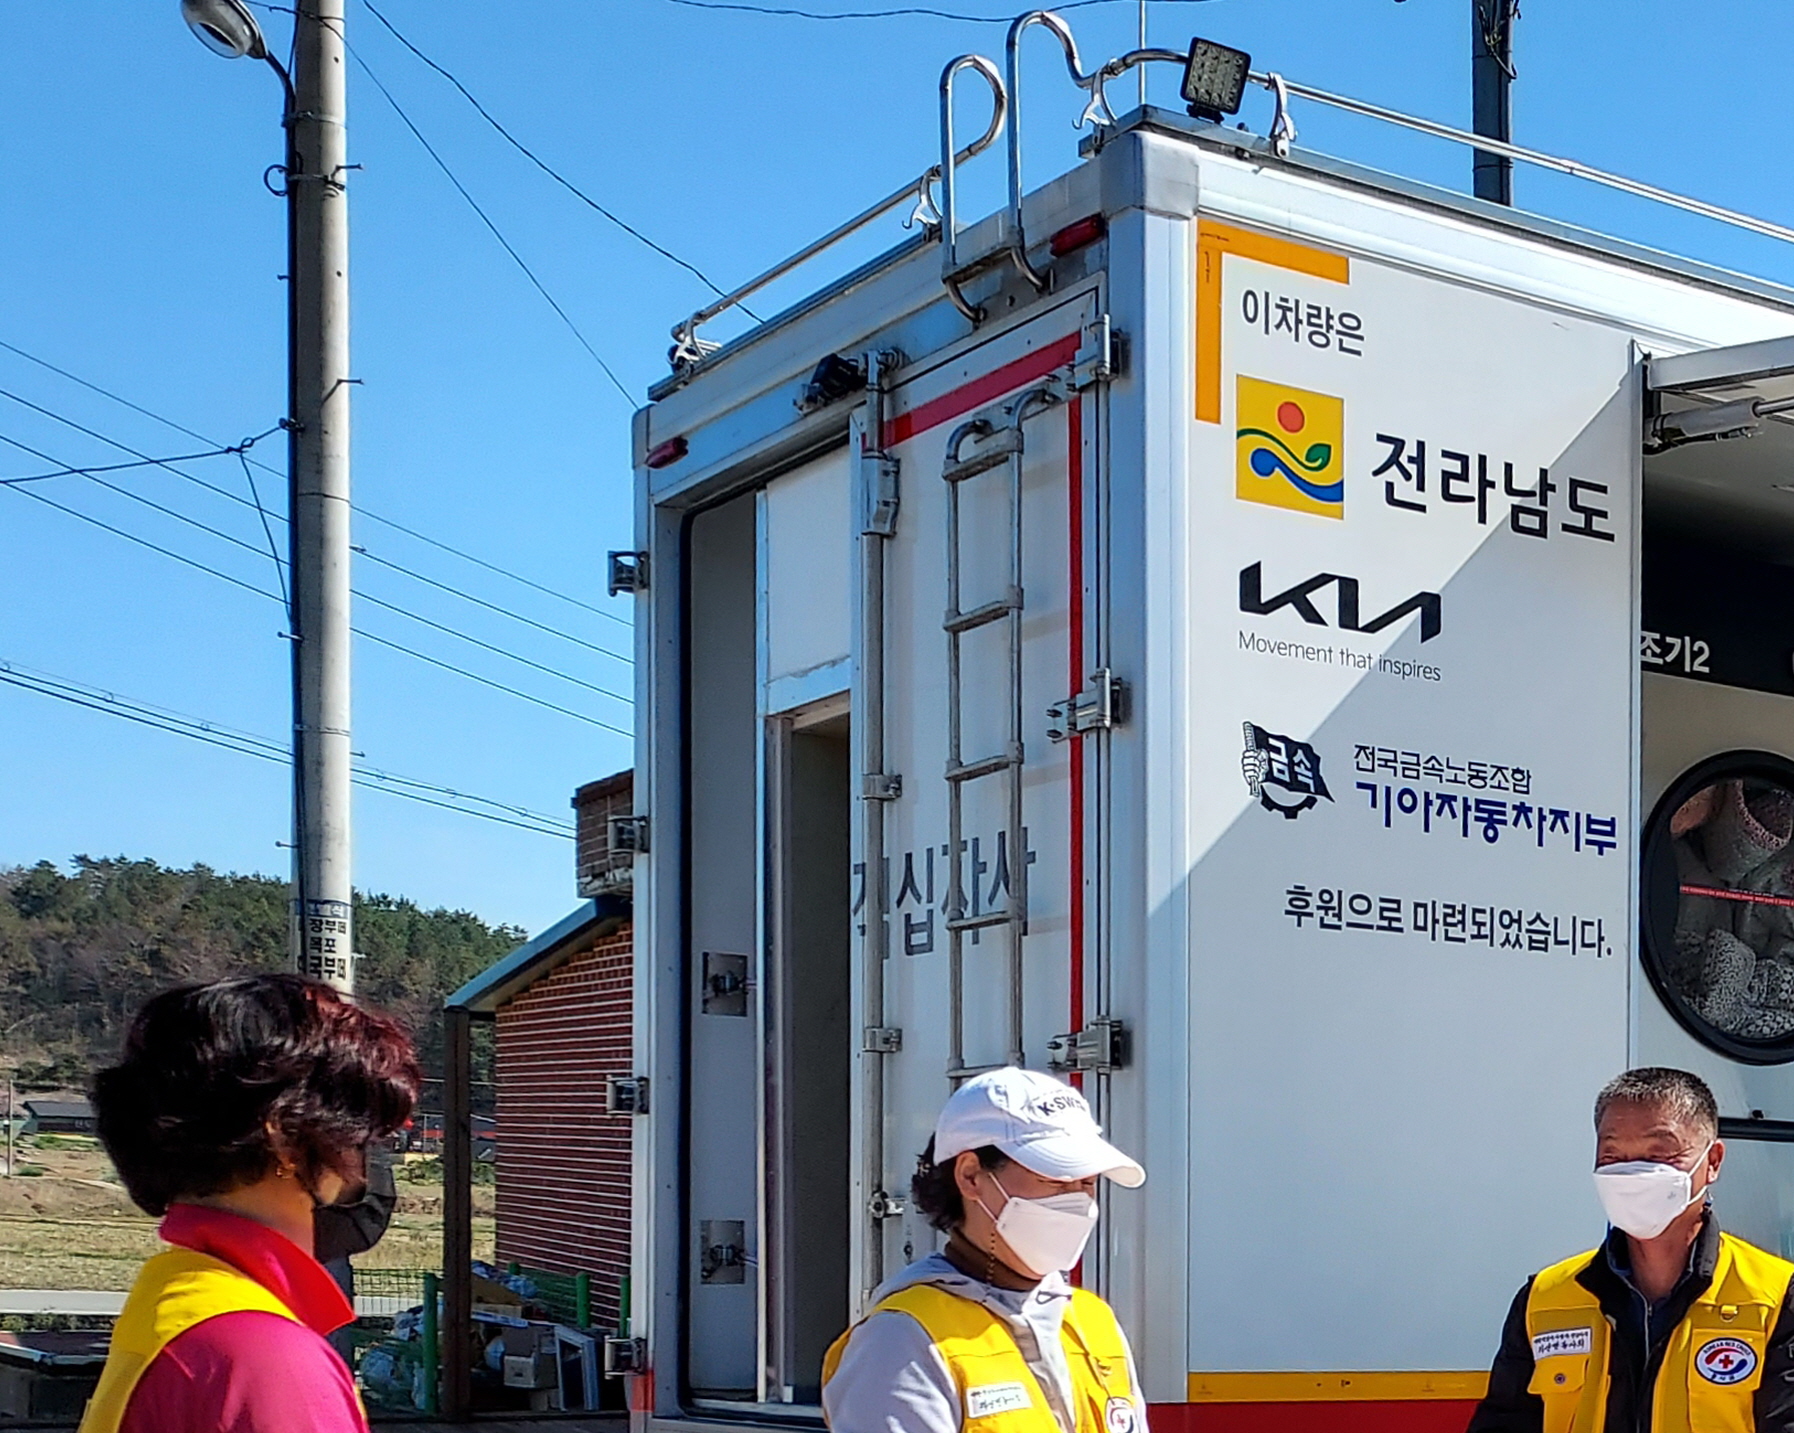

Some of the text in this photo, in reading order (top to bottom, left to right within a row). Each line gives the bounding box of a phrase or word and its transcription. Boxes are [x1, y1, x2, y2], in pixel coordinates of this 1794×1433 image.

[1242, 288, 1365, 356] 이차량은
[1371, 432, 1616, 544] 전라남도
[1238, 630, 1442, 682] Movement that inspires
[1353, 743, 1532, 796] 전국금속노동조합
[1355, 781, 1617, 856] 기아자동차지부
[1284, 884, 1613, 960] 후원으로 마련되었습니다.
